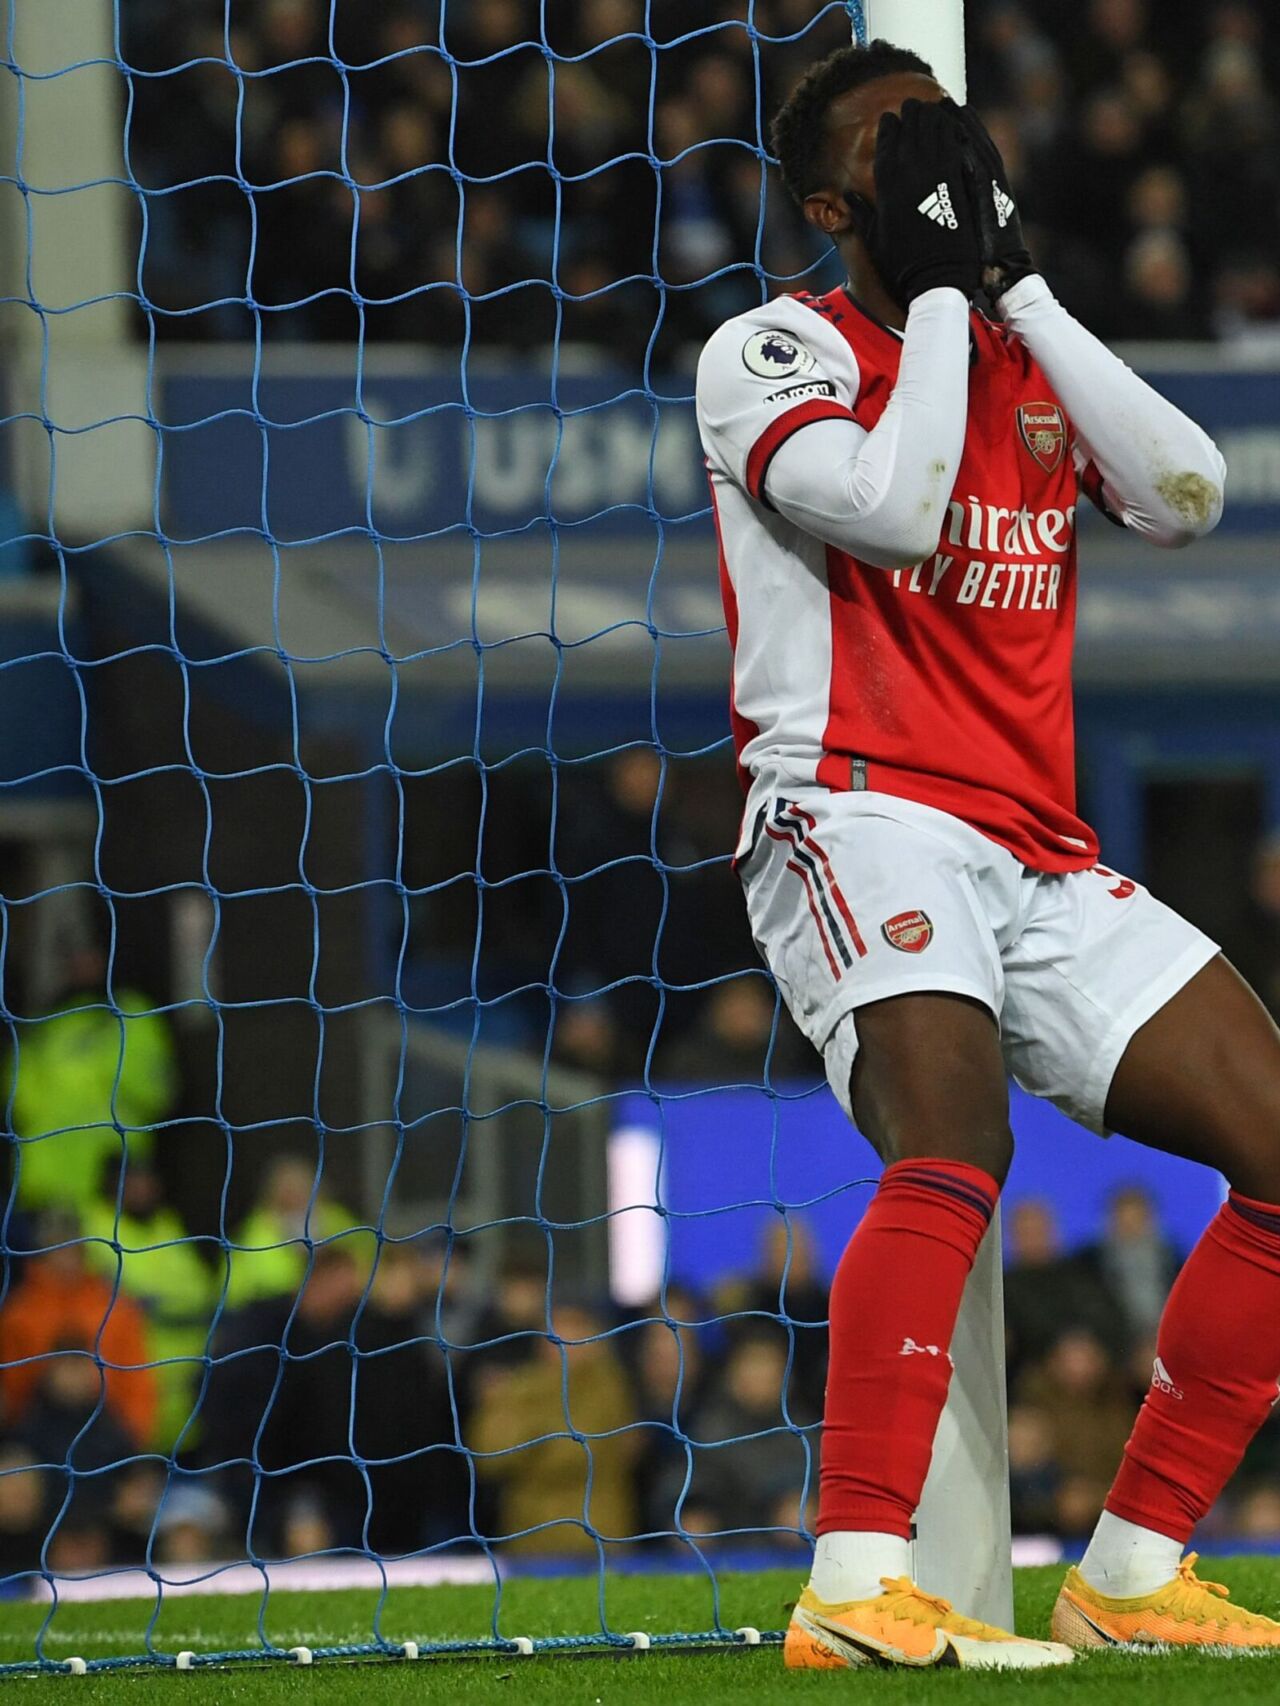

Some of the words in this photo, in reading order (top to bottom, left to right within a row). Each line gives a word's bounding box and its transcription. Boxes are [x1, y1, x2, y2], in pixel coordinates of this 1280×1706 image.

[937, 182, 958, 230] adidas
[789, 383, 830, 399] room
[1023, 413, 1059, 425] Arsenal
[948, 495, 1075, 556] irate
[956, 560, 1062, 611] BETTER
[888, 914, 923, 932] Arsenal
